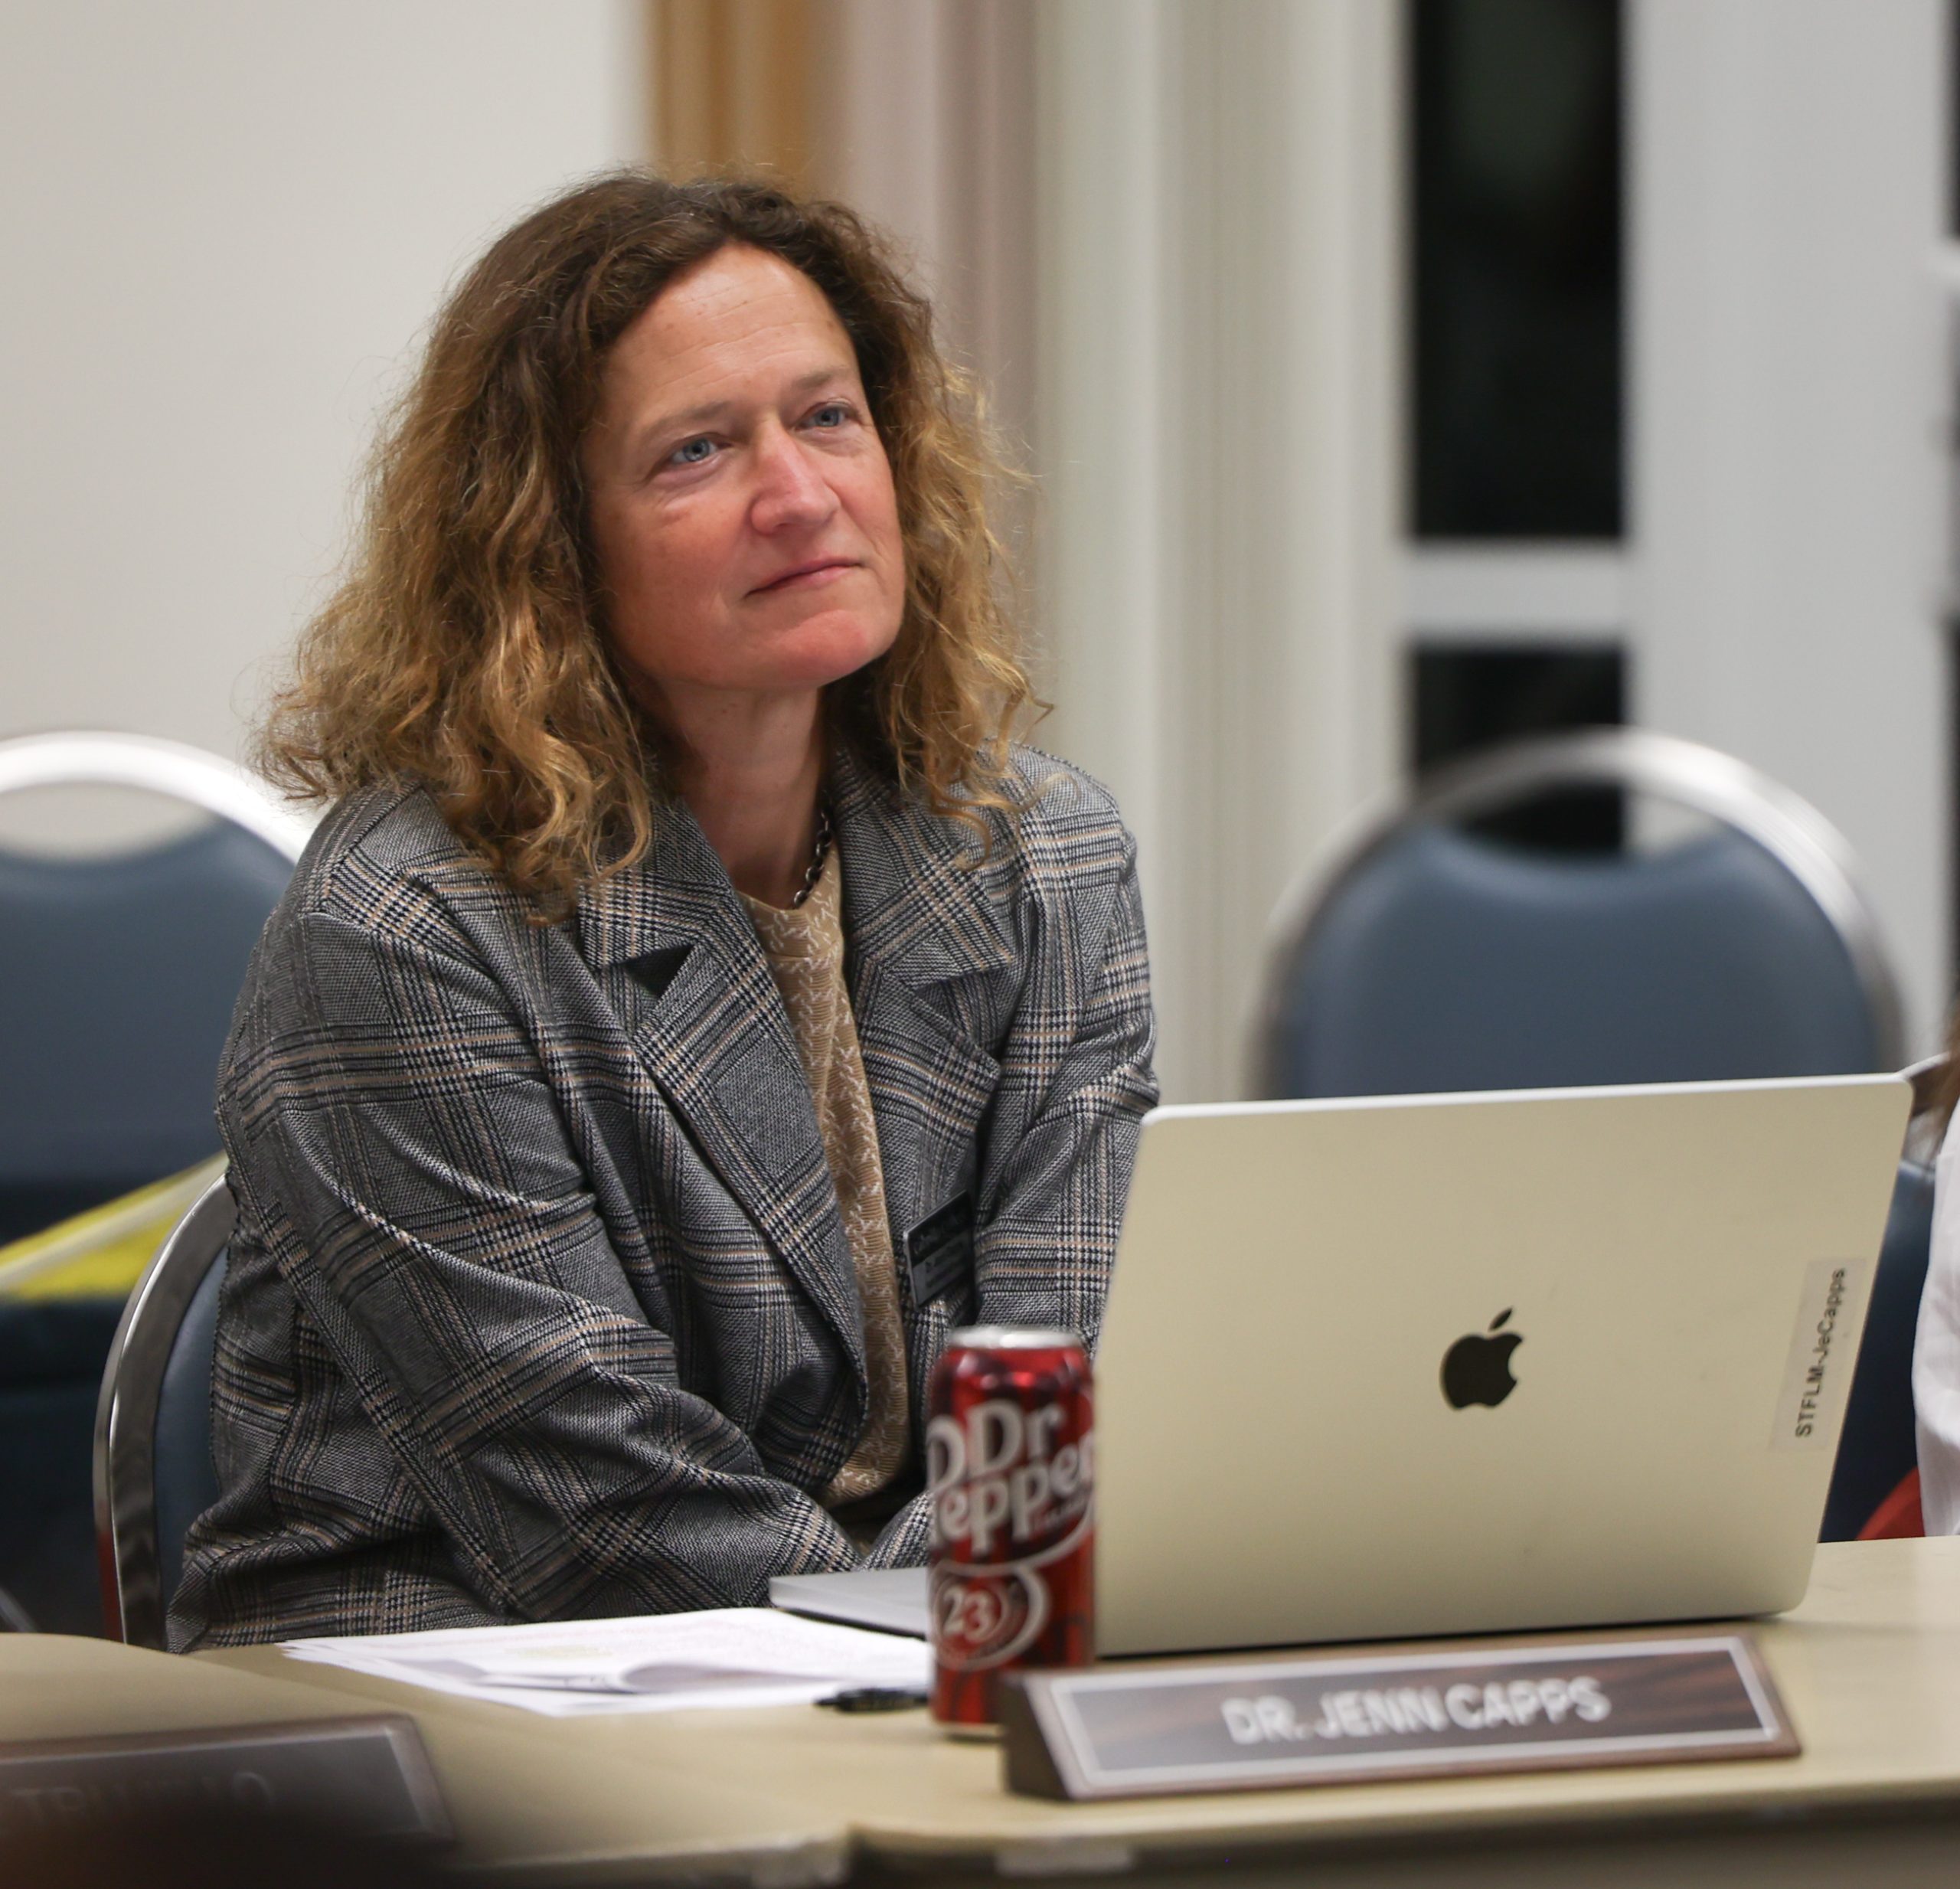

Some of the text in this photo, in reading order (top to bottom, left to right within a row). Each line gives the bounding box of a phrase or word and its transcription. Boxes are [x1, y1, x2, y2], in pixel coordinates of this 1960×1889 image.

[1795, 1267, 1845, 1438] STFLM-JeCapps
[965, 1397, 1065, 1479] Dr
[942, 1585, 995, 1644] 23
[1221, 1676, 1611, 1745] DR. JENN CAPPS
